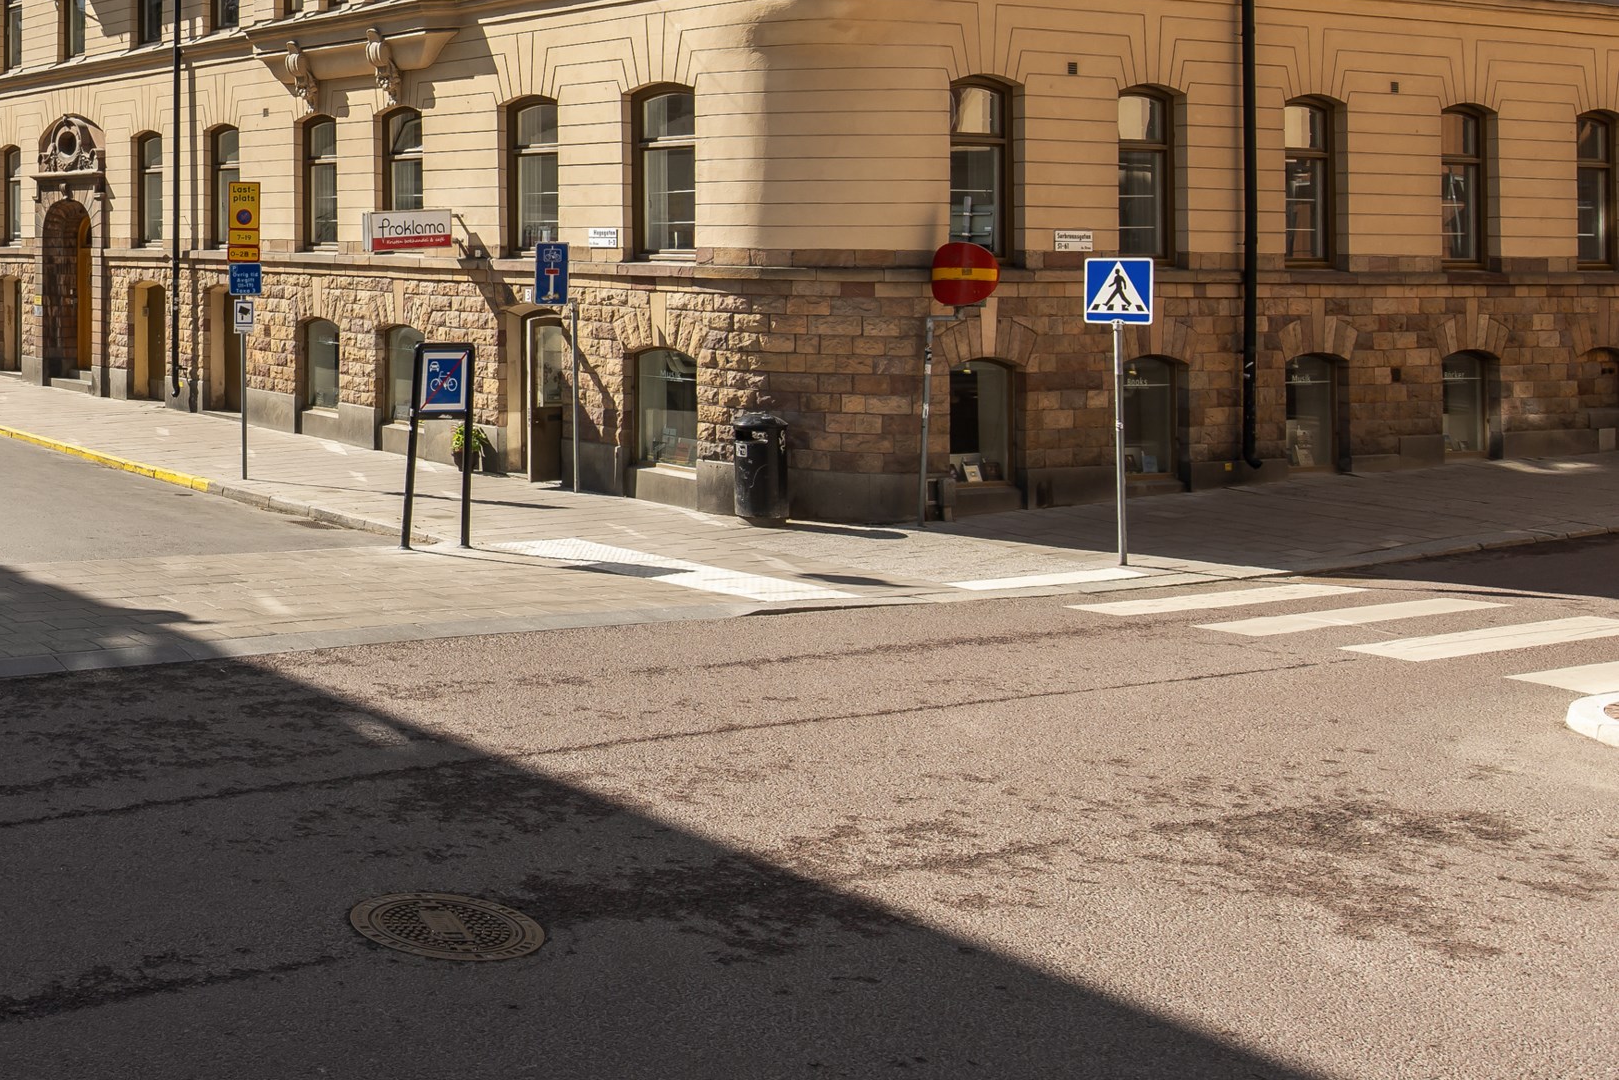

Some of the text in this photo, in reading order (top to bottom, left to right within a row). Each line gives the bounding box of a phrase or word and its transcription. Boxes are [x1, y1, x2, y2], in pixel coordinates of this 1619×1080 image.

[232, 185, 256, 193] Last-
[233, 194, 255, 203] plats
[378, 217, 446, 241] Proklama
[1127, 377, 1148, 386] Books
